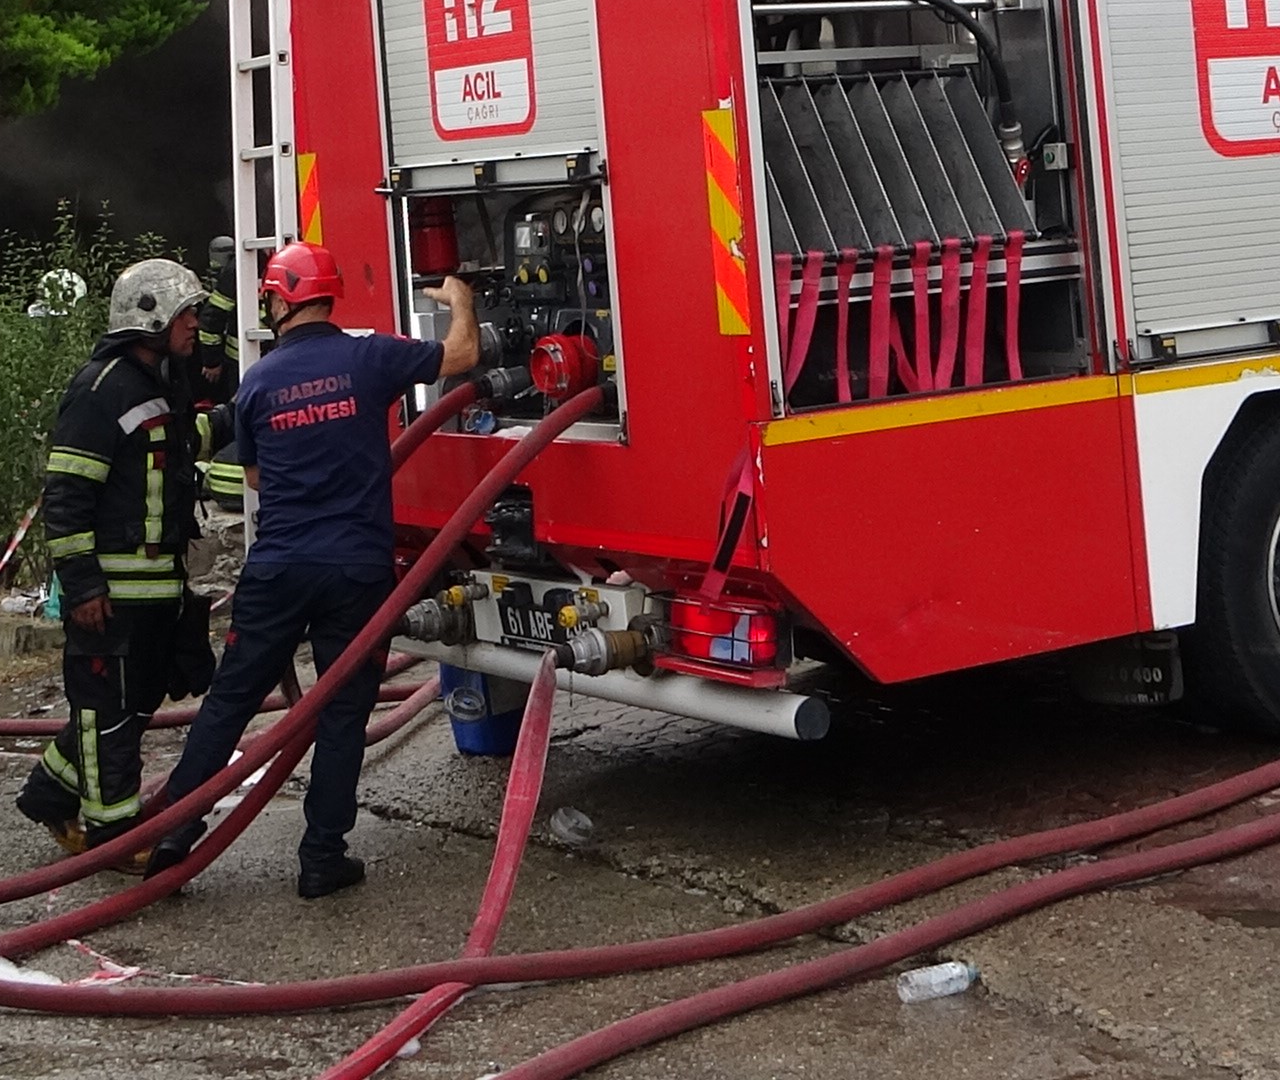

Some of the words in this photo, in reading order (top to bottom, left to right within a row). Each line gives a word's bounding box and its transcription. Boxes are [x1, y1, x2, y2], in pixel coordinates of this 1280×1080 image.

[462, 70, 501, 102] ACİL
[467, 101, 499, 123] ÇAĞRI
[266, 373, 352, 406] TRABZON
[271, 396, 357, 431] İTFAİYESİ
[507, 606, 524, 636] 61
[529, 610, 554, 640] ABF
